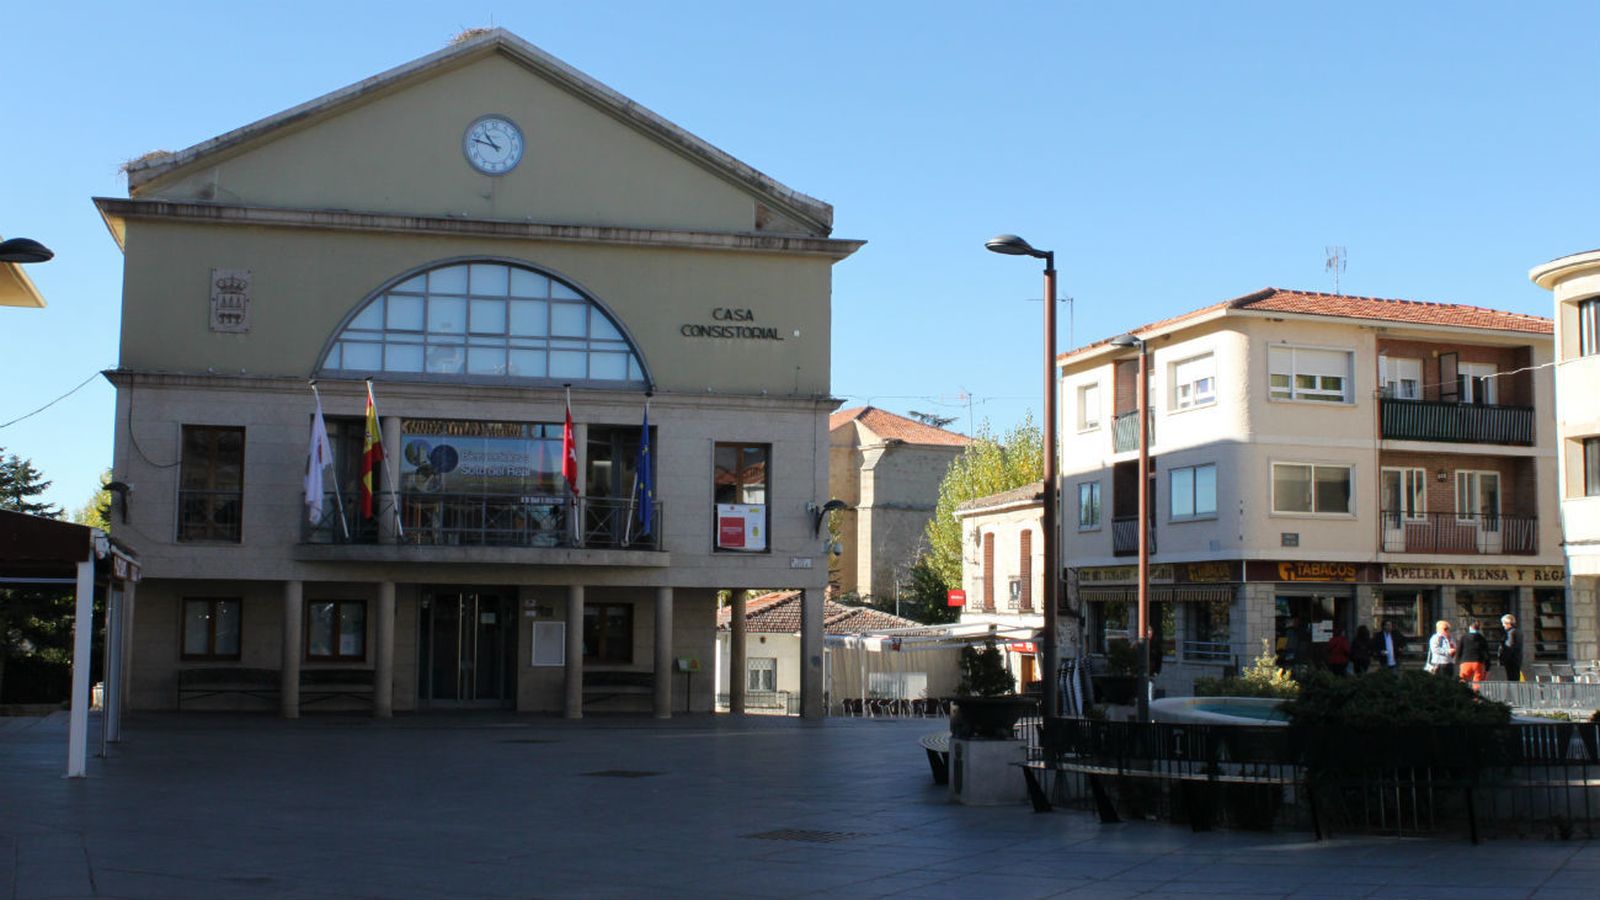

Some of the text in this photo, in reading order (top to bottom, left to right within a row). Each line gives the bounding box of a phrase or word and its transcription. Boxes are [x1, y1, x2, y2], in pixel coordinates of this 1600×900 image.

[712, 308, 754, 322] CASA
[681, 324, 784, 340] CONSISTORIAL
[1296, 562, 1356, 577] TABACOS
[1385, 567, 1455, 581] PAPELERIA
[1461, 568, 1509, 582] PRENSA
[1517, 569, 1526, 582] Y
